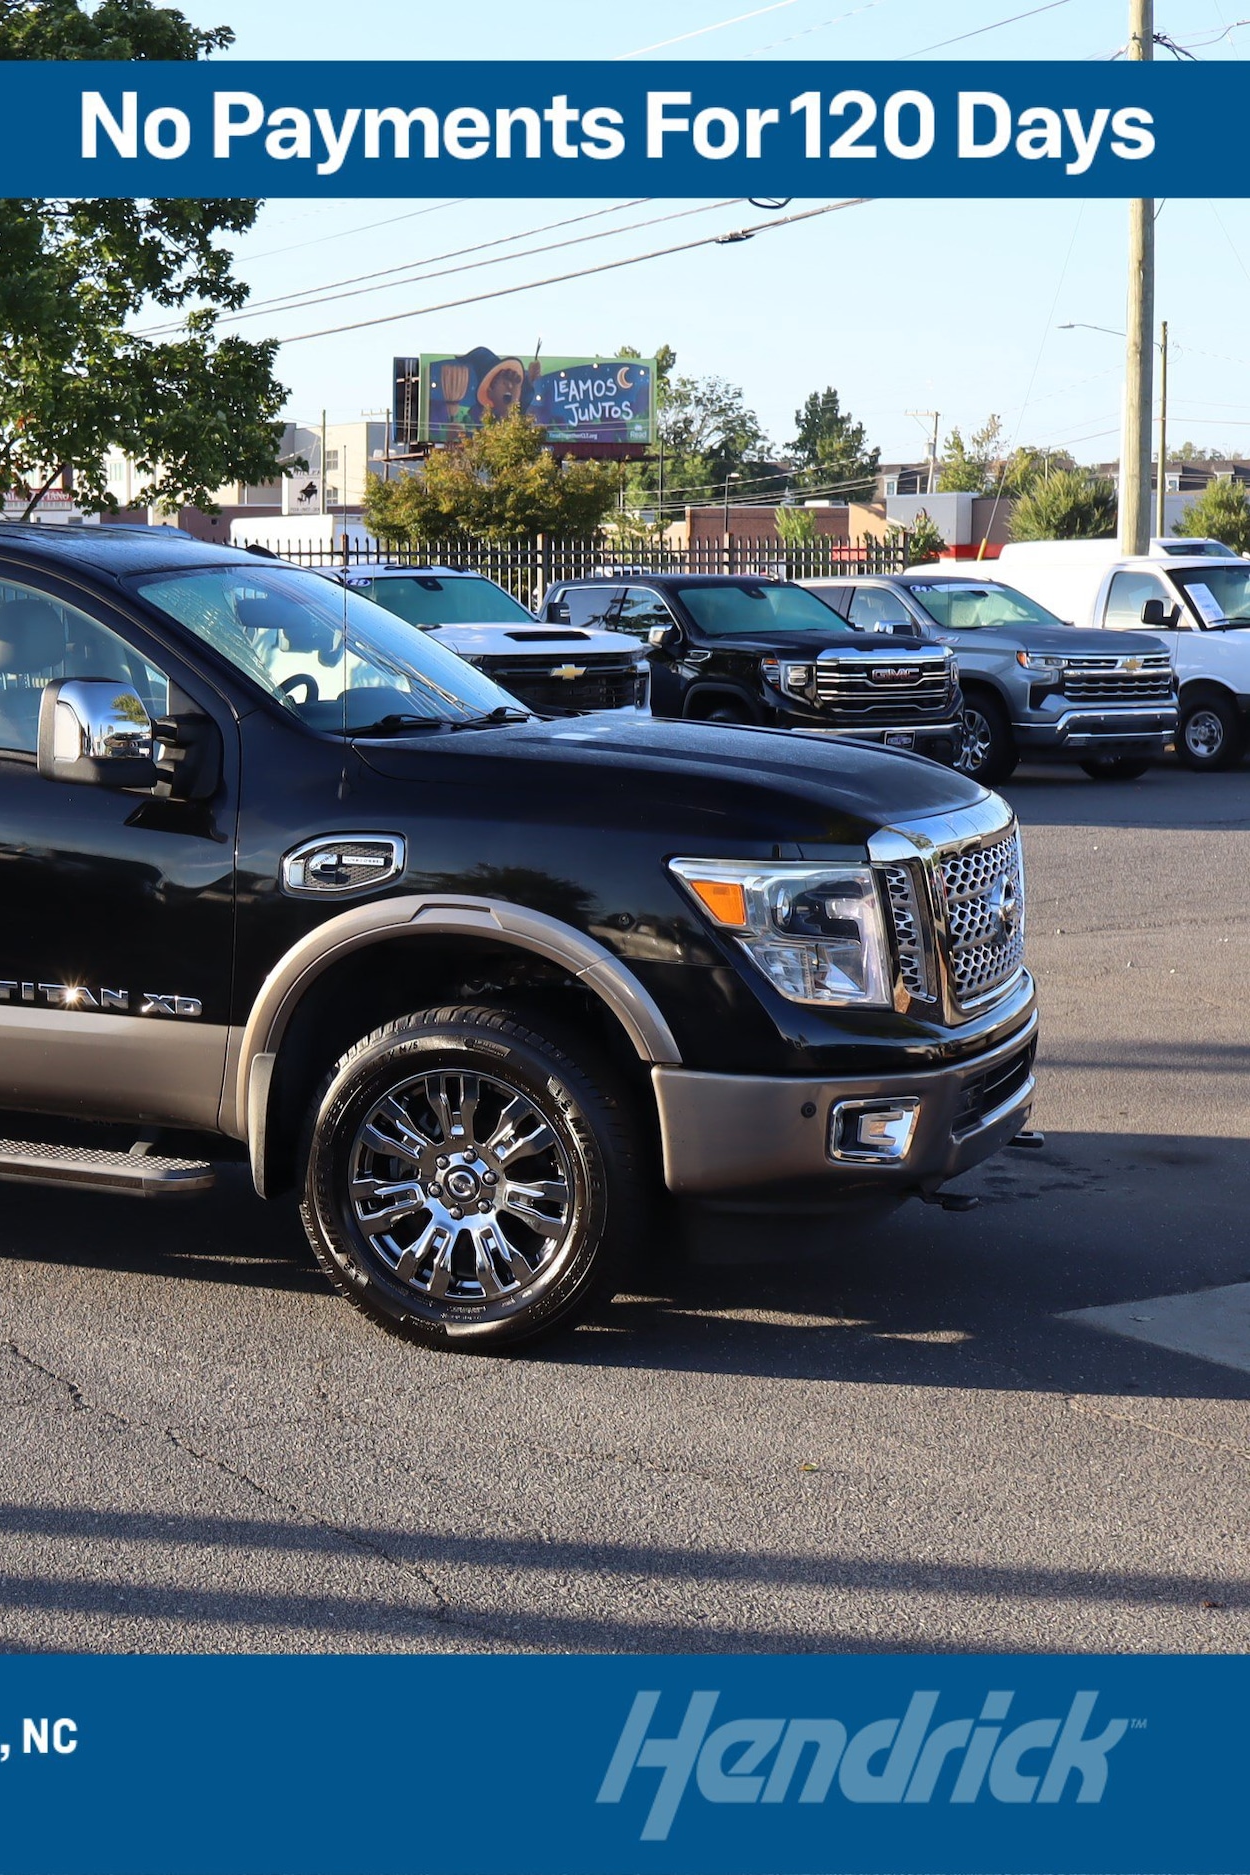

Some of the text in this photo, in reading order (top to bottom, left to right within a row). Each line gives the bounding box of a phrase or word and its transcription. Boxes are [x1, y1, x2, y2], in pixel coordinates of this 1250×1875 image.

[554, 378, 617, 402] LEAMOS
[564, 401, 633, 427] JUNTOS
[872, 668, 920, 681] GMC
[141, 992, 203, 1016] XD
